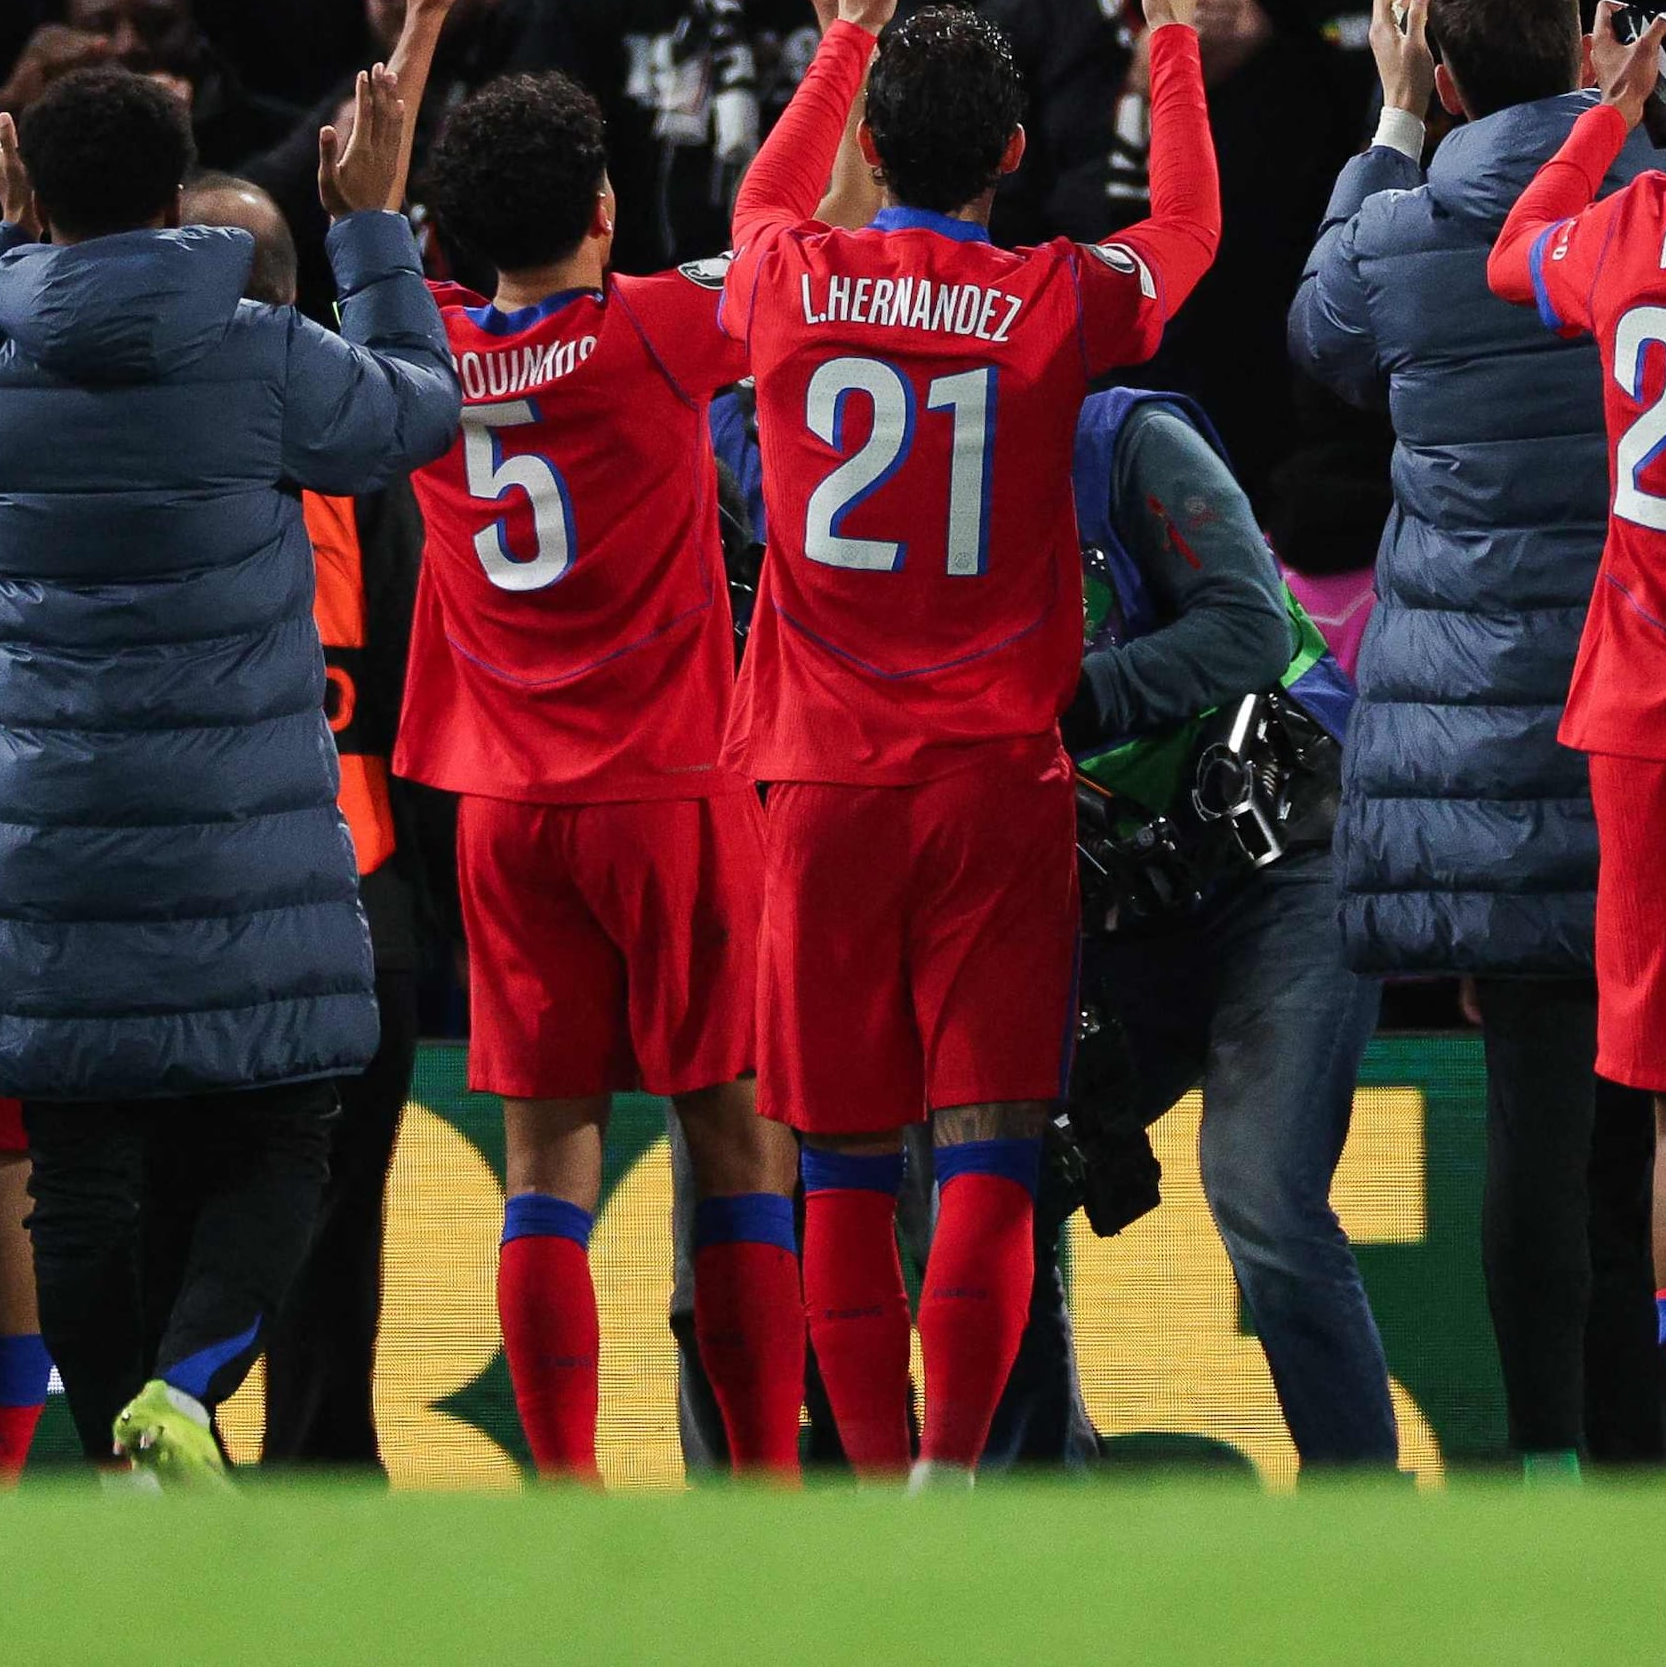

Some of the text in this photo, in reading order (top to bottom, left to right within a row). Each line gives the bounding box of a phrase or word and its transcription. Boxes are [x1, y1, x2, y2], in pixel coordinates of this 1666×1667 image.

[801, 273, 1023, 344] L.HERNANDEZ
[459, 396, 578, 592] 5
[803, 355, 999, 577] 21
